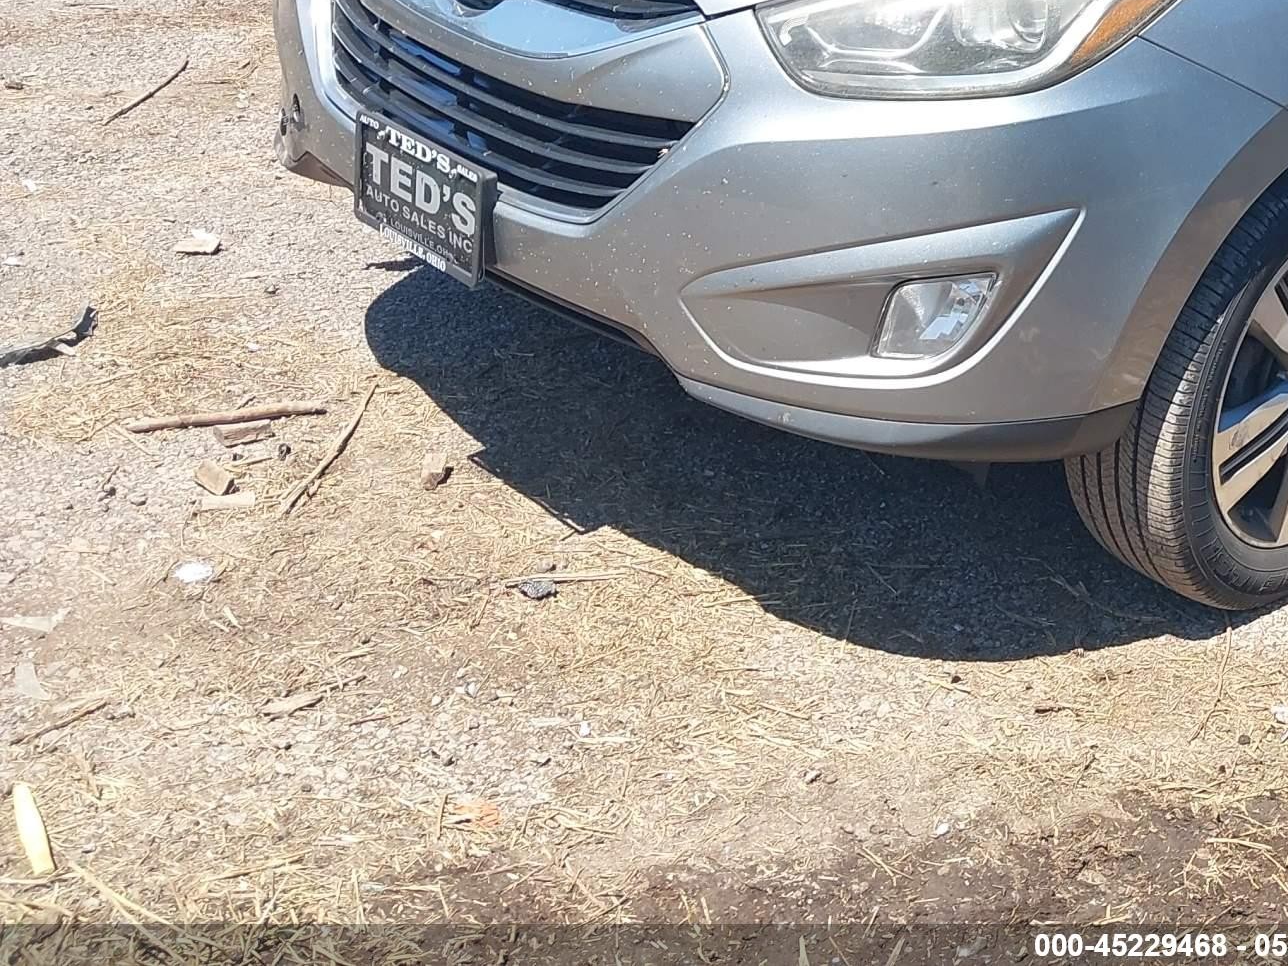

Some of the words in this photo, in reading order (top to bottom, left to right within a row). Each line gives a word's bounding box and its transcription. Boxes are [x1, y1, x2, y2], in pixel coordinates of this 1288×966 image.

[359, 115, 380, 130] AUTO
[385, 125, 450, 174] TED'S
[365, 142, 476, 235] TED'S
[366, 185, 400, 213] AUTO
[402, 205, 446, 239] SALES
[449, 230, 473, 253] INC
[426, 252, 447, 272] OHIO
